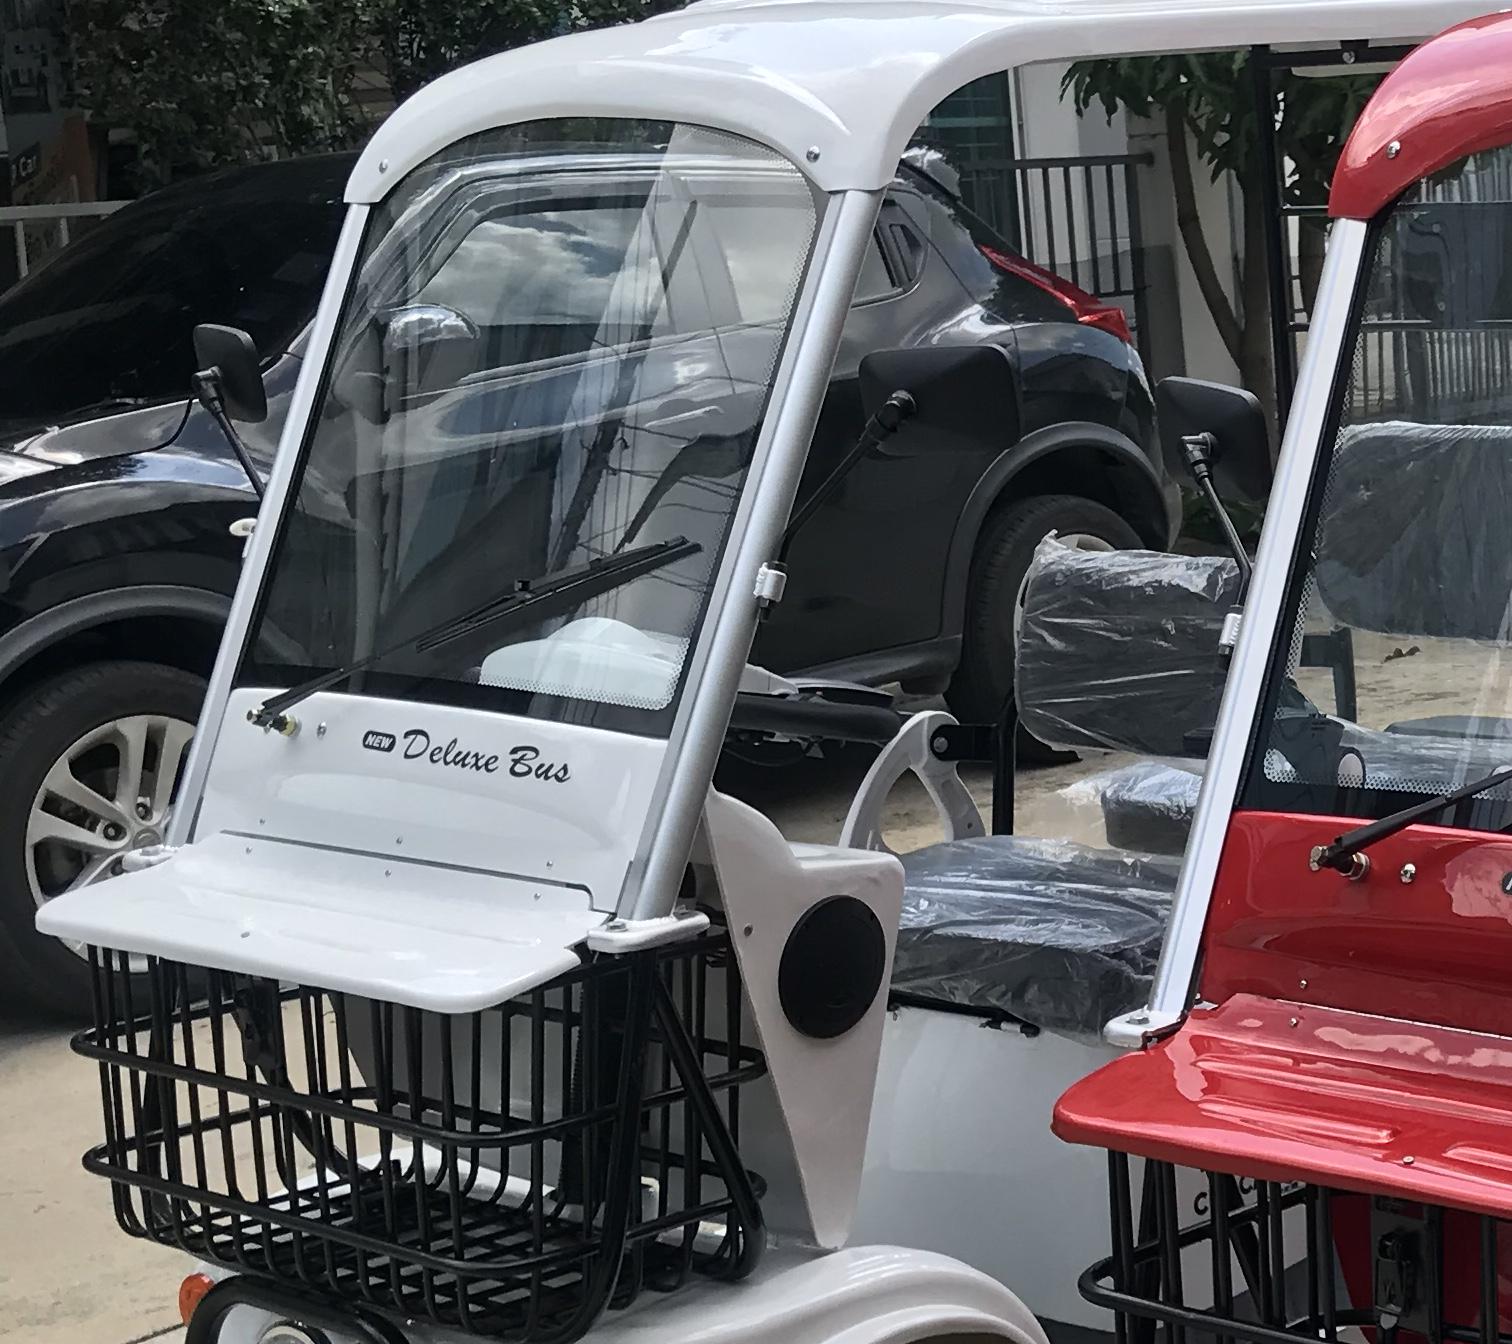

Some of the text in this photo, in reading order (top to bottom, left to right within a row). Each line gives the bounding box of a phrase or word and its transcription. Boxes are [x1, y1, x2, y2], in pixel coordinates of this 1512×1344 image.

[364, 728, 571, 784] NEW Deluxe Bus
